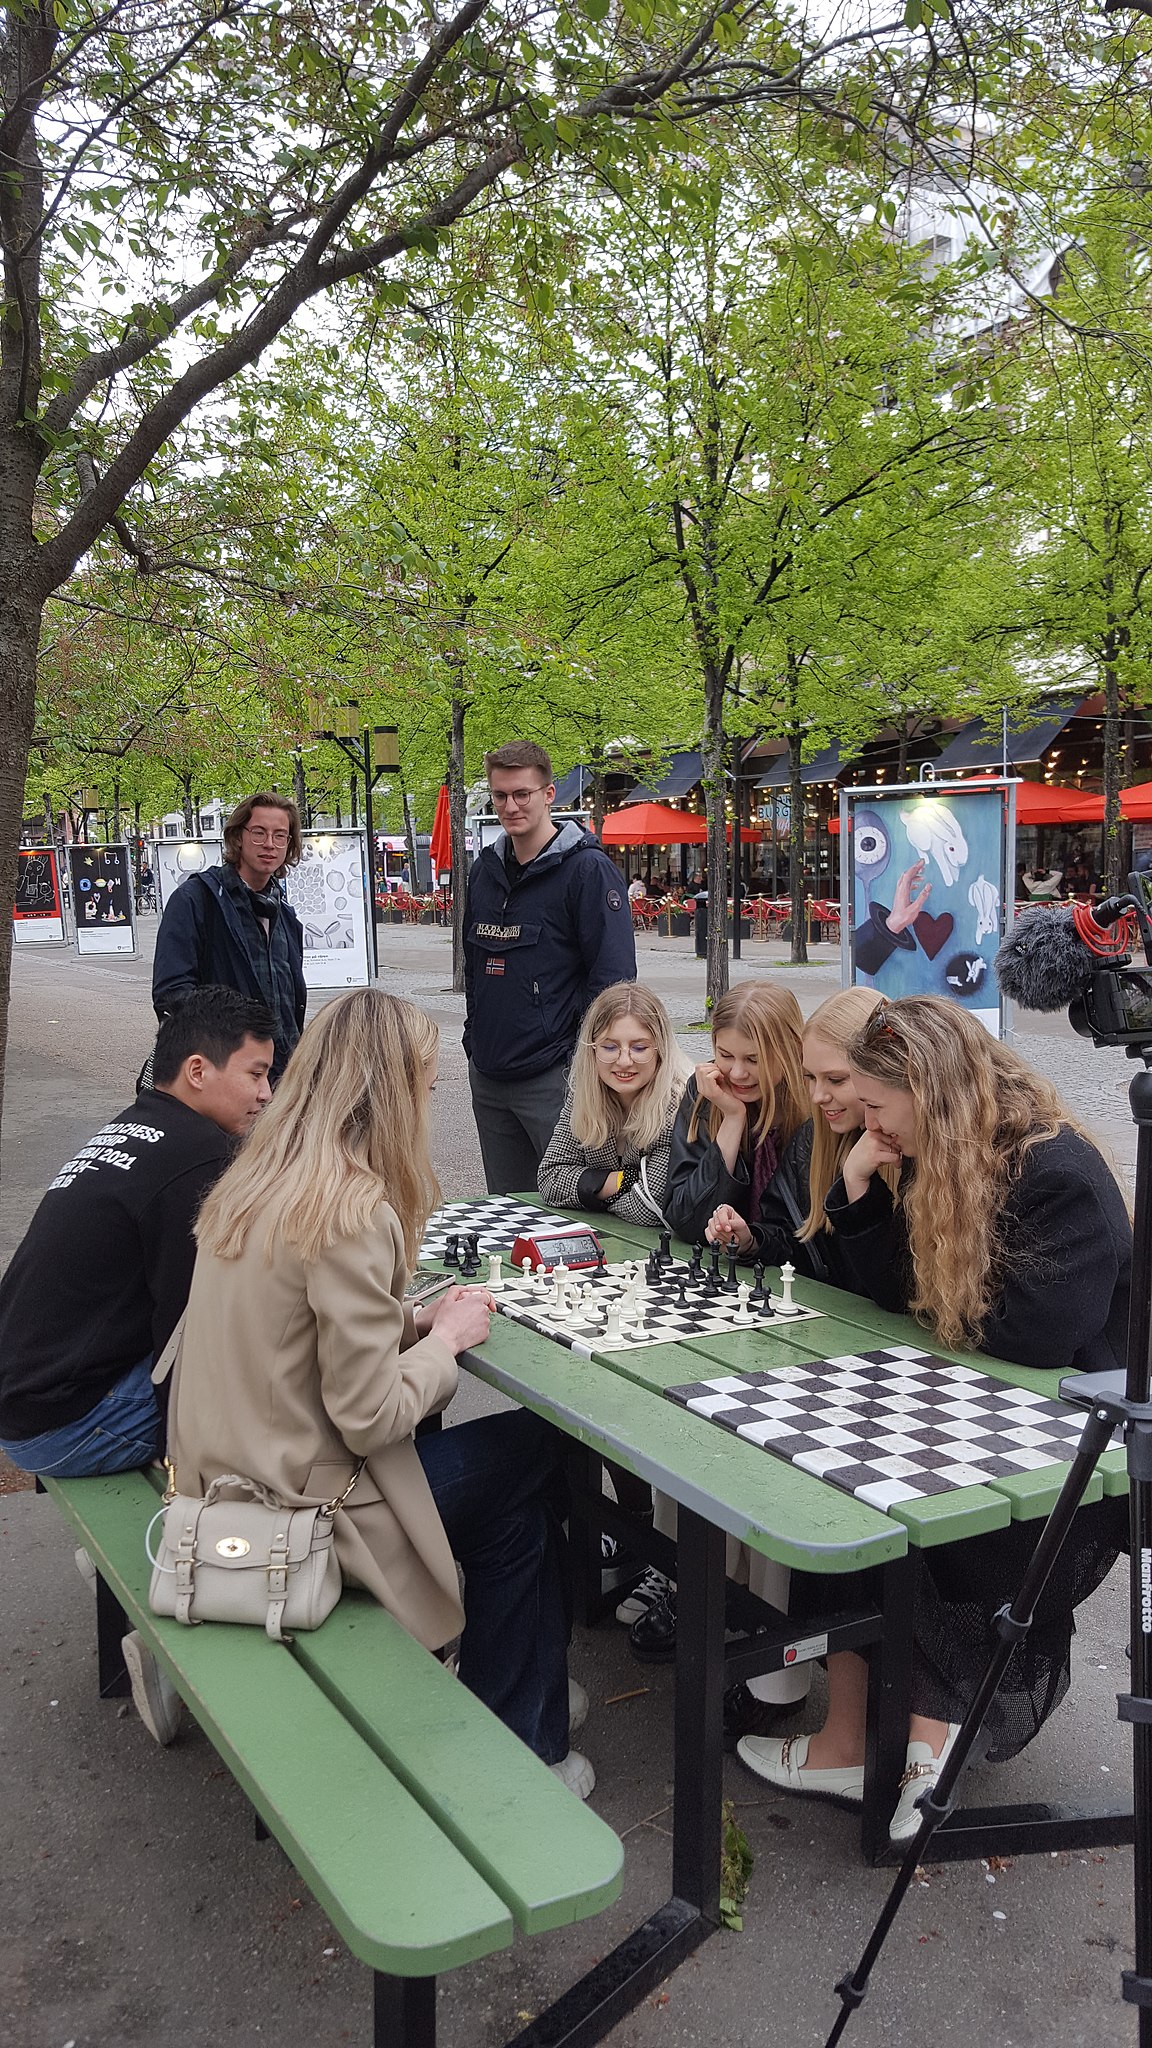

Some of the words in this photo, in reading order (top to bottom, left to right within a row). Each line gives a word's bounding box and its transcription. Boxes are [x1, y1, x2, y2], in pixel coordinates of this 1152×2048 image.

[121, 1123, 165, 1143] CHESS
[98, 1148, 138, 1170] 2021
[1141, 1548, 1152, 1633] Manfrotto
